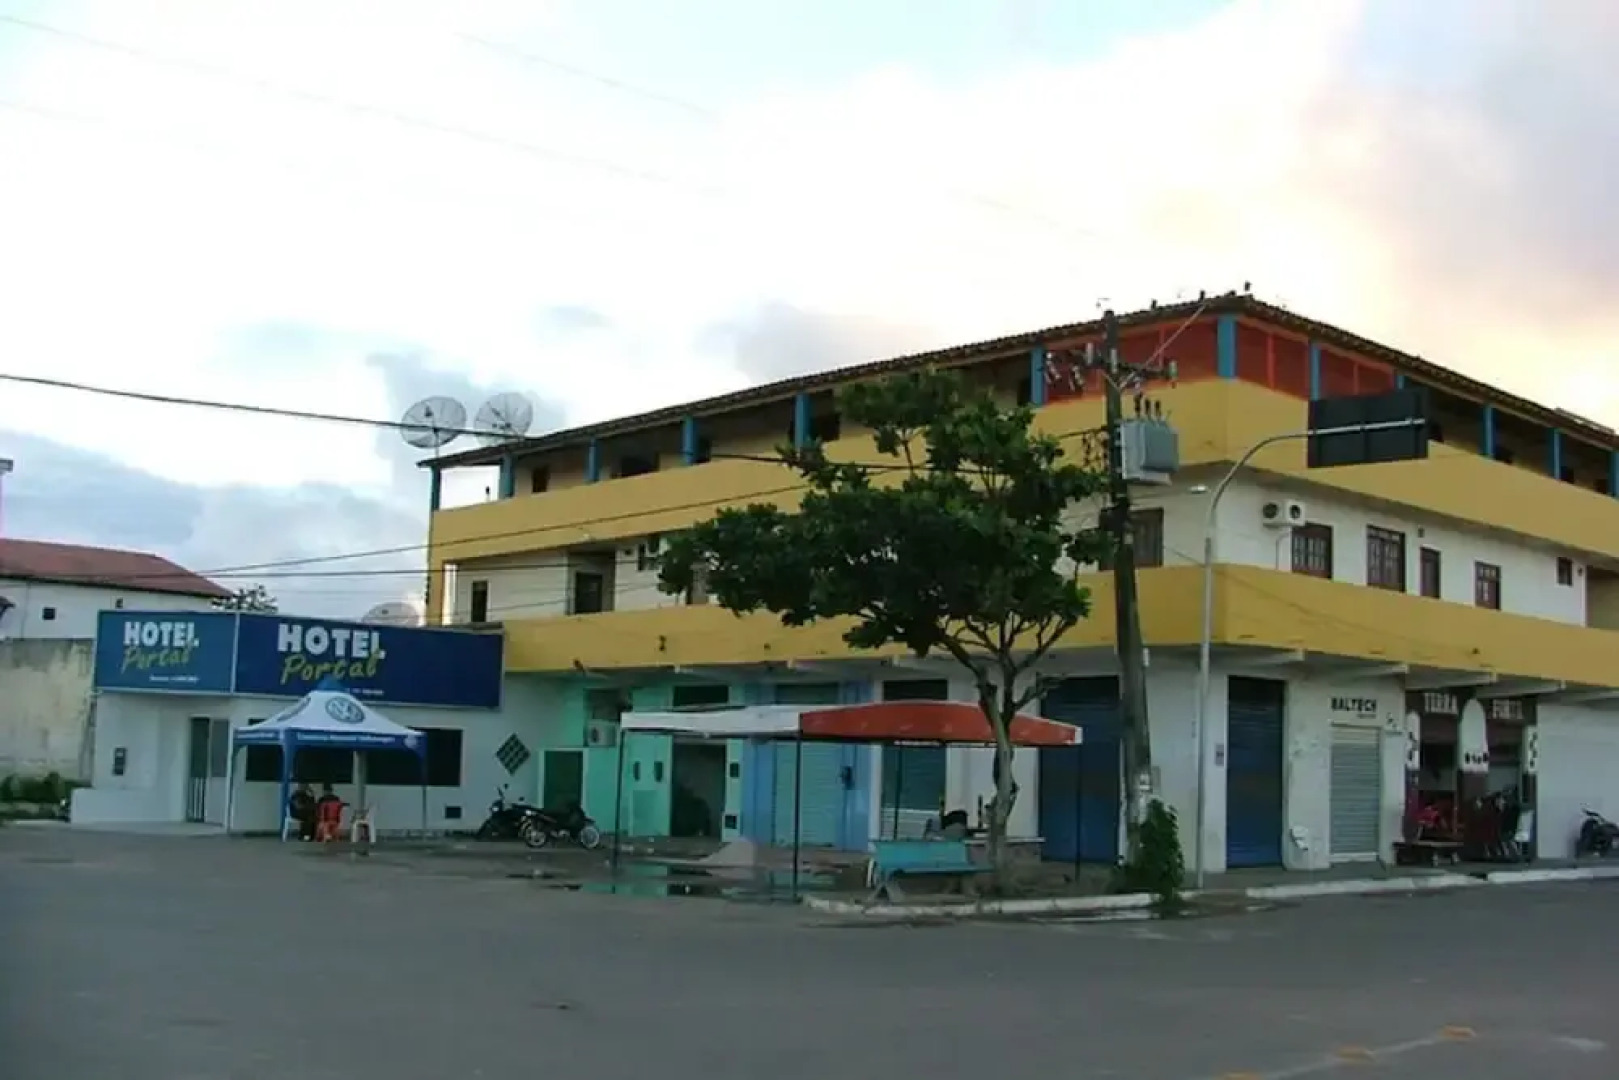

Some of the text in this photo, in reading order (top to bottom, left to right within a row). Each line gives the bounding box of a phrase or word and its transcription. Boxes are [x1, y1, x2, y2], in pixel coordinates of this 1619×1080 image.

[123, 621, 200, 647] HOTEL
[277, 624, 387, 659] HOTEL
[279, 650, 381, 686] Portal
